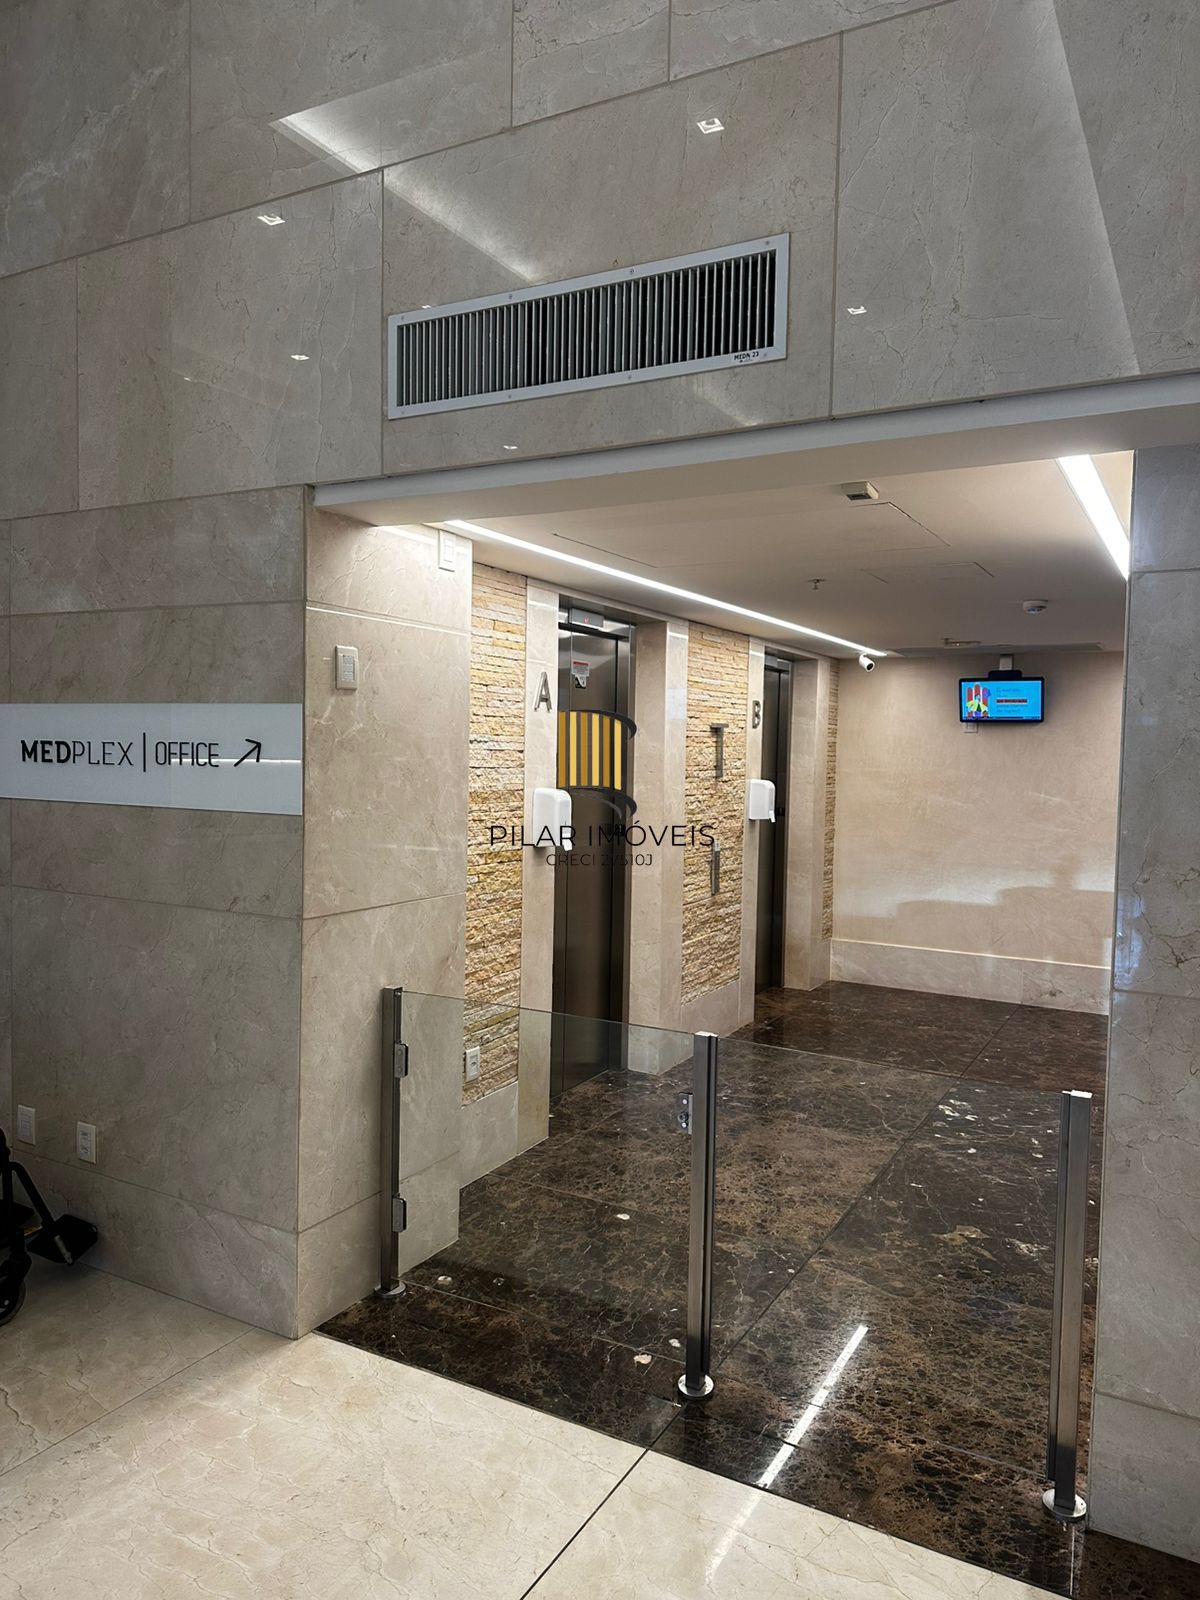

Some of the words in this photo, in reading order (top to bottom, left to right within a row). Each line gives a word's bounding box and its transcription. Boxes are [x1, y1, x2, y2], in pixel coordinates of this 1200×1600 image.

[534, 671, 553, 713] A
[752, 700, 762, 729] B
[20, 740, 135, 766] MEDPLEX
[155, 741, 220, 768] OFFICE
